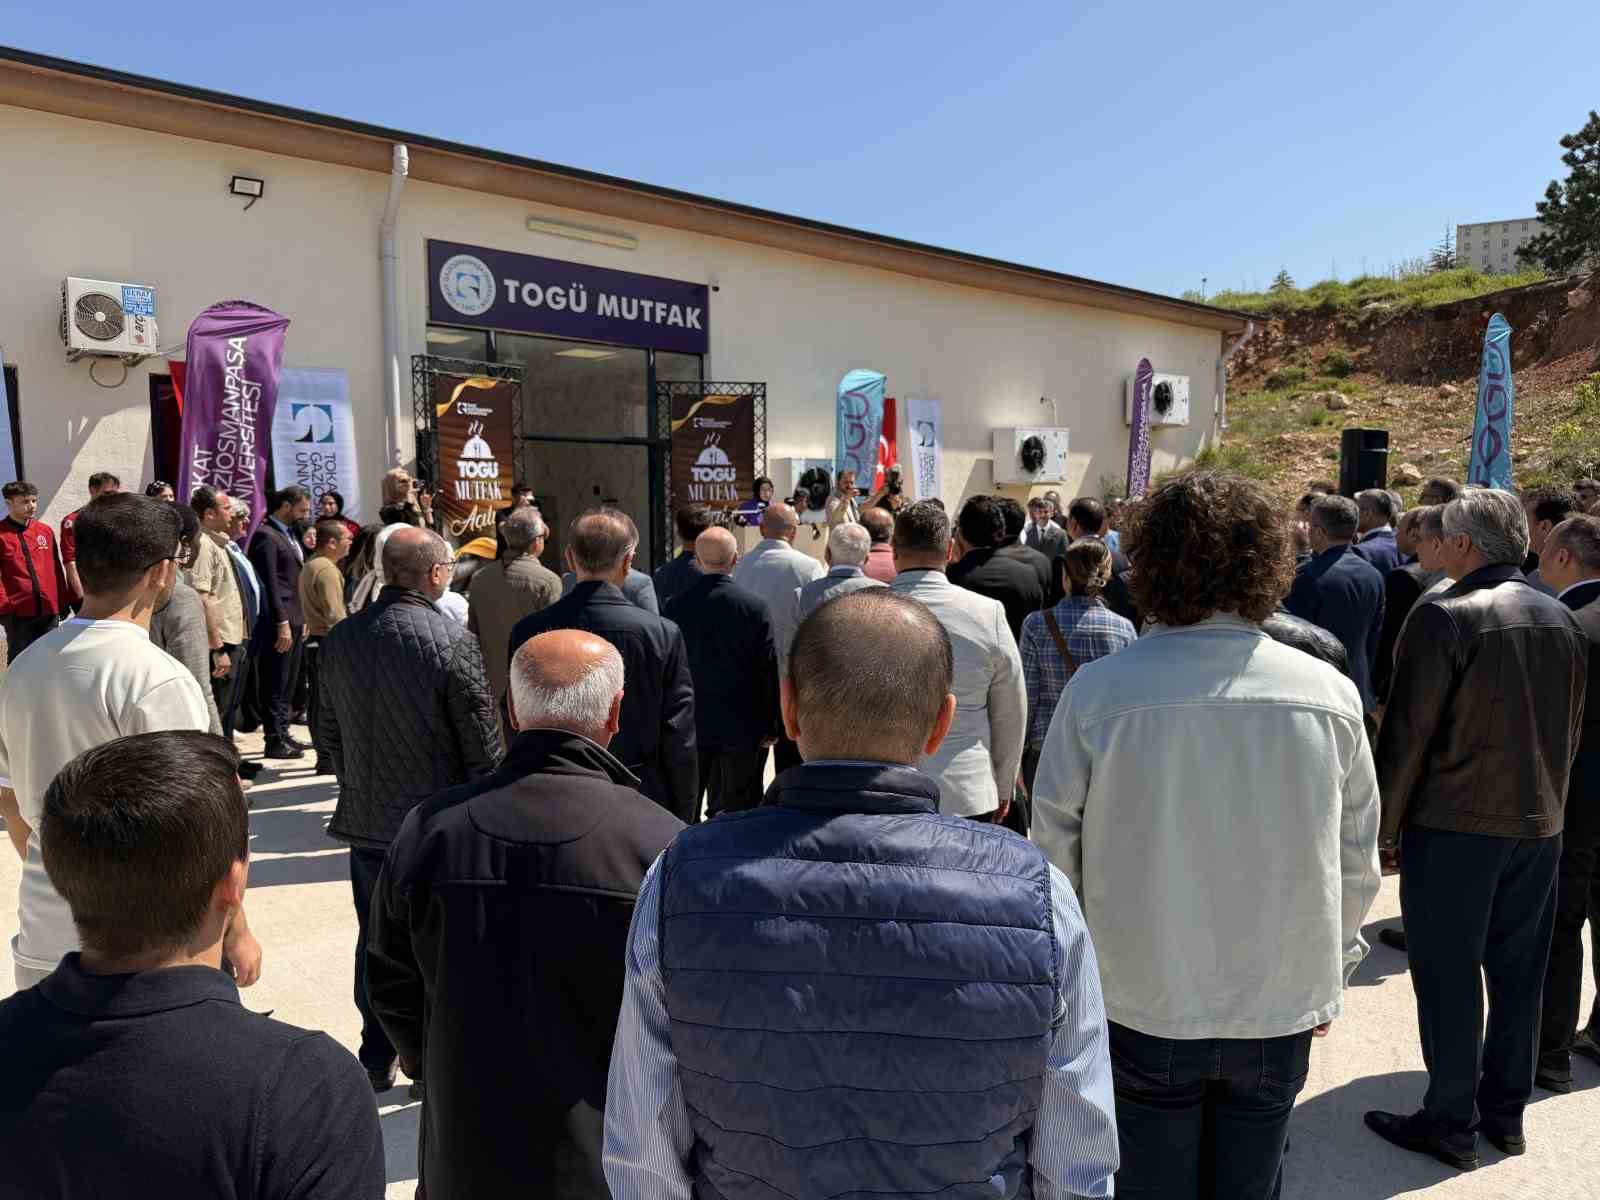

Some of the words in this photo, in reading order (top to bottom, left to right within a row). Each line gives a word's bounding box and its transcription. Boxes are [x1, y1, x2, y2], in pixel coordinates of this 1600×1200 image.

[503, 278, 587, 314] TOGÜ
[597, 293, 702, 330] MUTFAK
[840, 390, 870, 479] OGÜ
[324, 452, 337, 493] TOKA
[455, 480, 503, 501] MUTFAK
